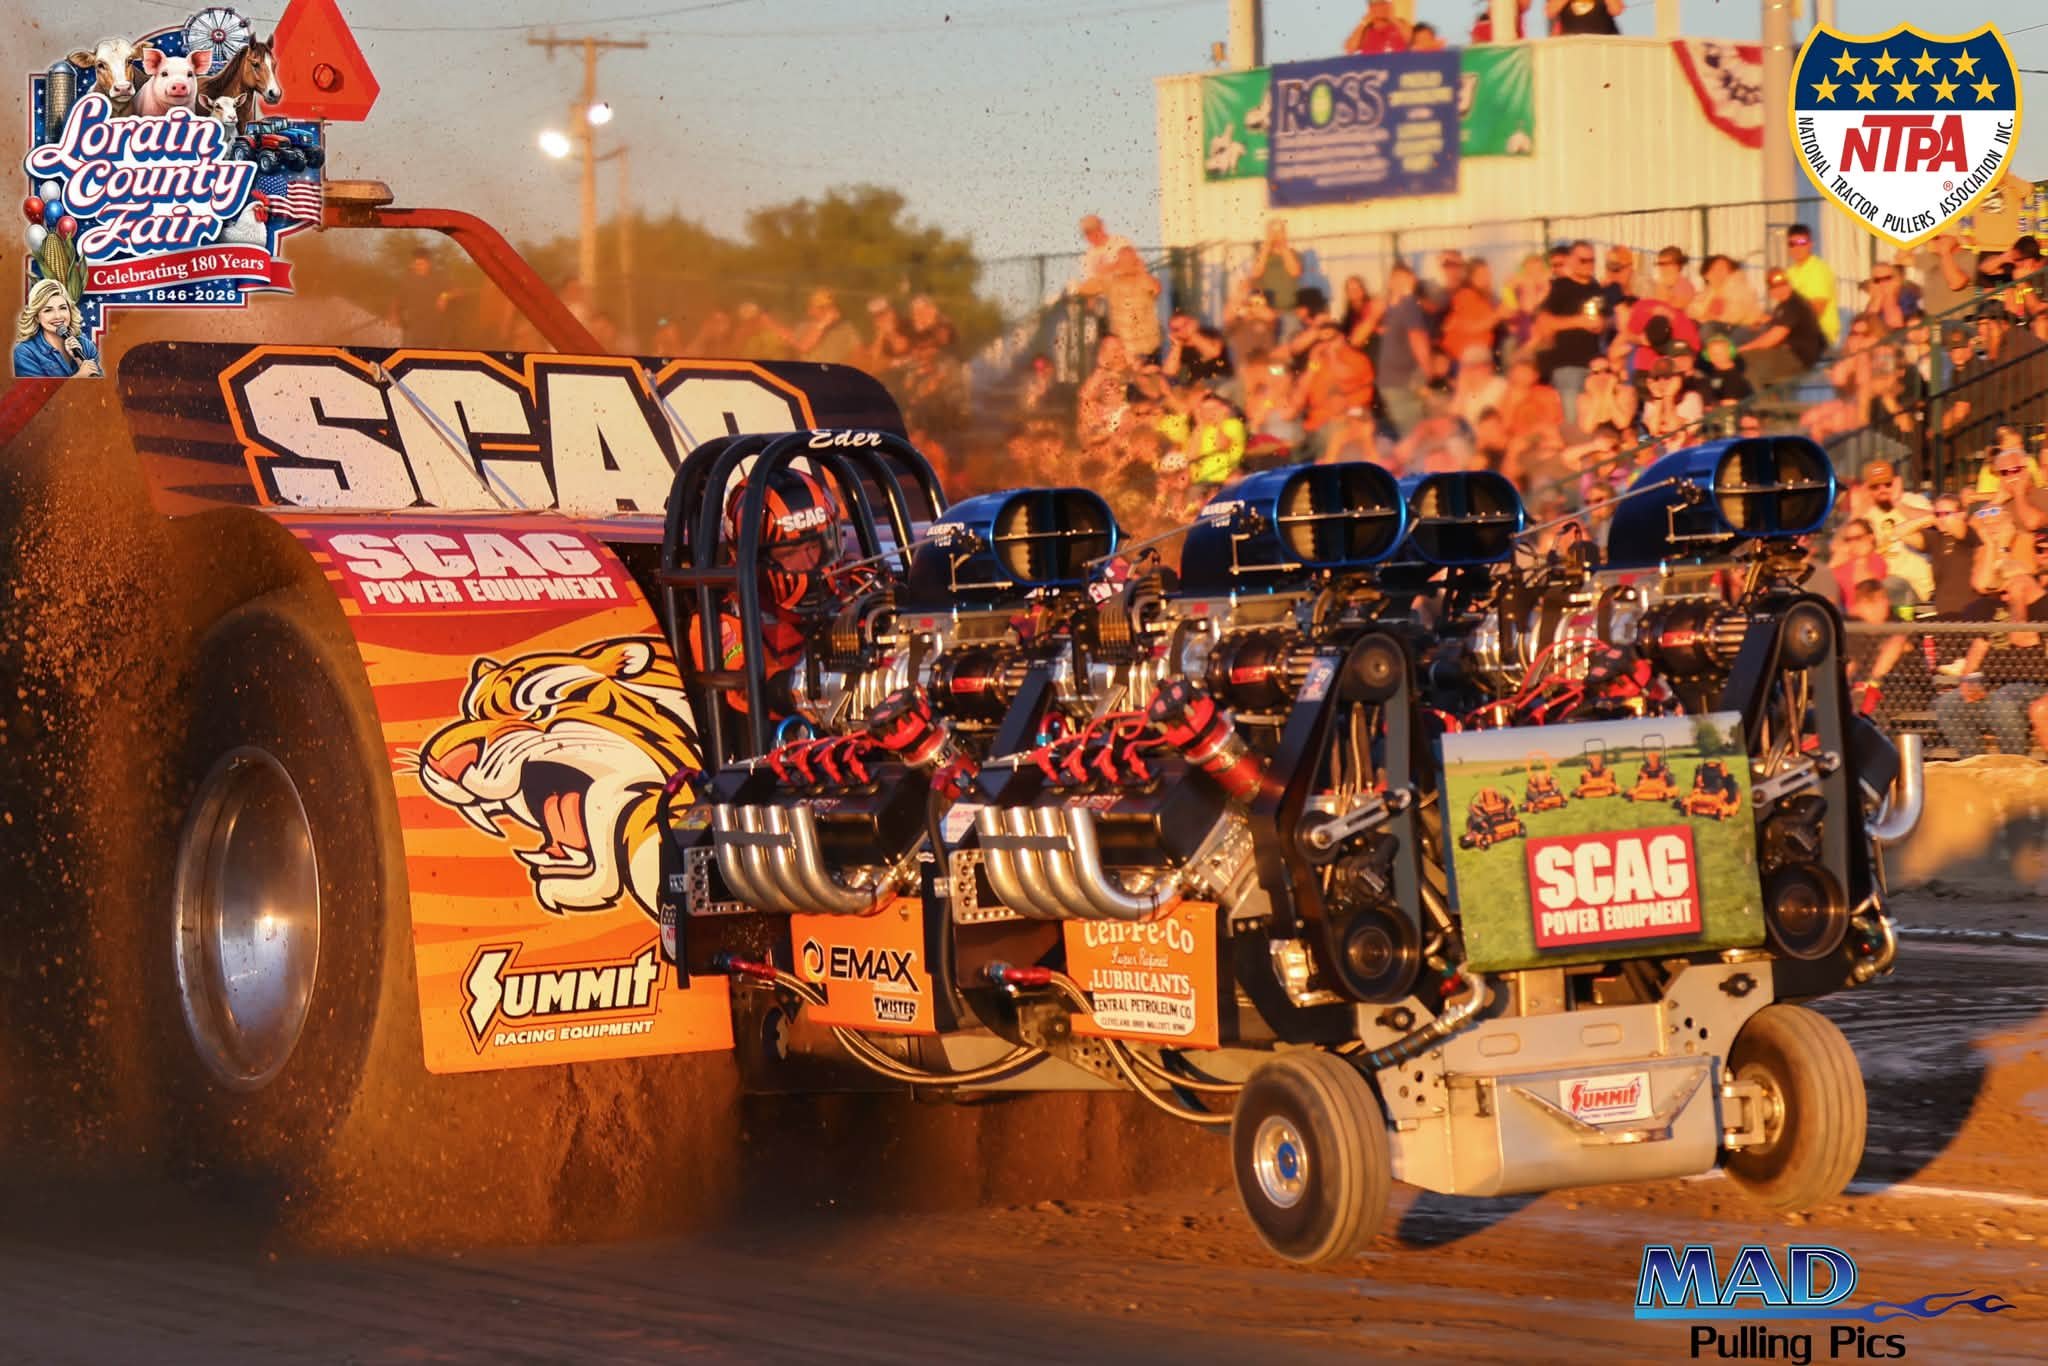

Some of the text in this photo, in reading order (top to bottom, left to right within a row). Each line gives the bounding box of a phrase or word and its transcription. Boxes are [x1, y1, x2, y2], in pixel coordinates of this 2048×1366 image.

[1277, 71, 1389, 135] ROSS
[808, 429, 882, 449] Eder
[782, 506, 827, 533] SCAG
[328, 533, 602, 579] SCAG
[360, 577, 618, 605] POWER EQUIPMENT
[1534, 834, 1691, 909] SCAG
[1541, 898, 1692, 937] POWER EQUIPMENT
[830, 946, 920, 993] EMAX
[1093, 969, 1190, 995] LUBRICANTS
[874, 997, 916, 1016] TWISTER
[1131, 999, 1178, 1017] PETROLEUM
[494, 1020, 654, 1046] RACING EQUIPMENT
